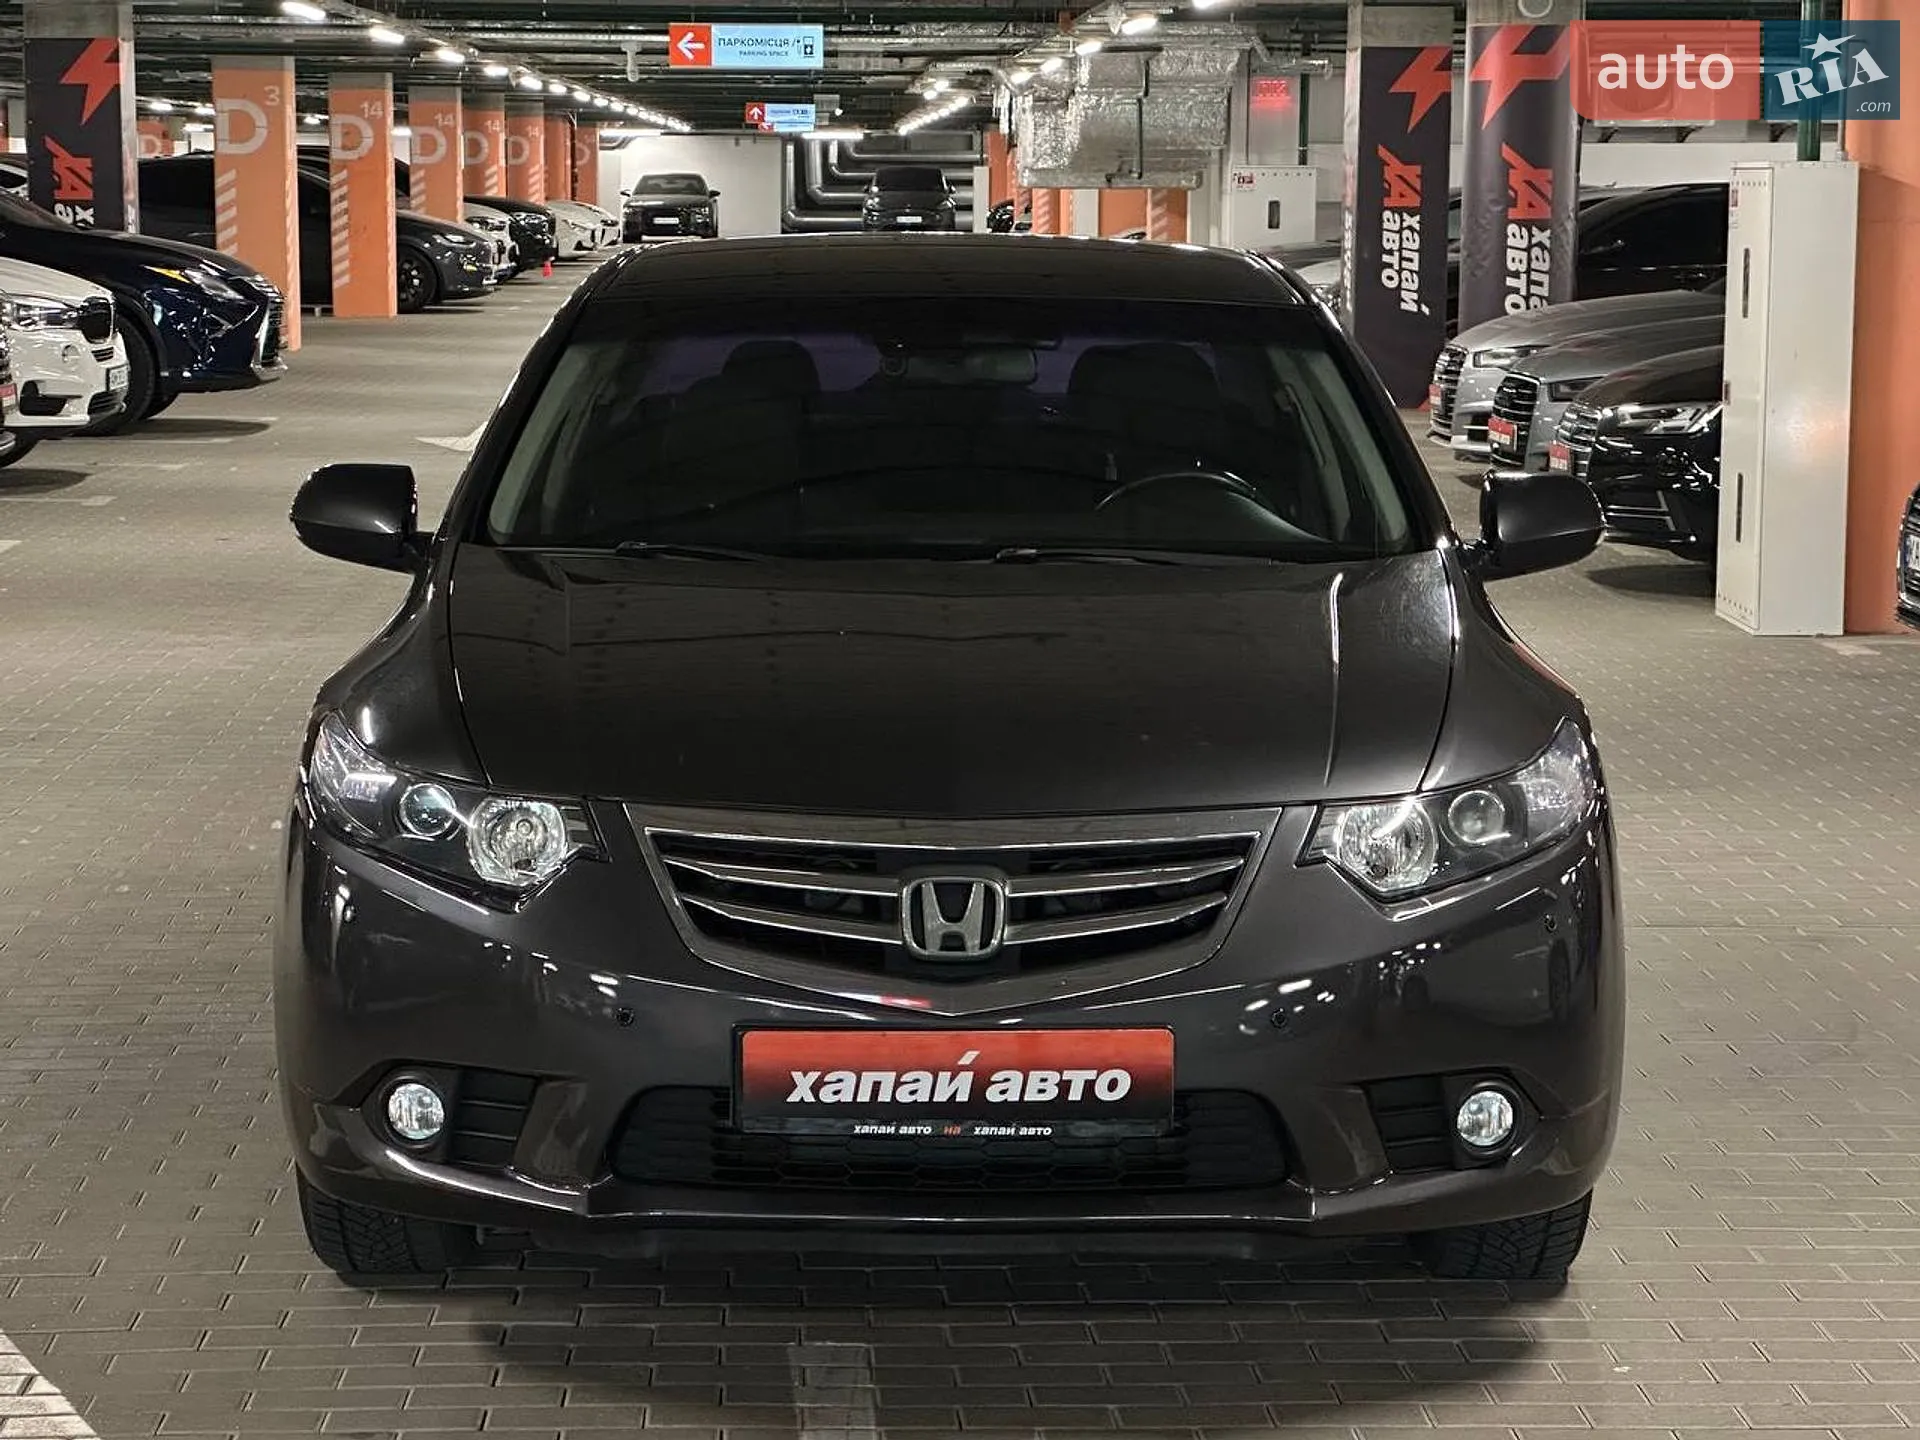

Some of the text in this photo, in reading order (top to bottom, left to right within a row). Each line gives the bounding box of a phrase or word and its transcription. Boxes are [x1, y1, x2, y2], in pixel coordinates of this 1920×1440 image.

[717, 37, 789, 48] ПАРКОМІСЦЯ
[215, 85, 281, 155] D 3
[330, 101, 384, 160] D 14
[411, 112, 456, 164] D 14
[464, 119, 501, 165] D 14
[507, 135, 530, 165] D
[1381, 210, 1400, 289] авто
[1400, 212, 1430, 316] хапай
[1505, 223, 1529, 316] авто
[786, 1050, 1132, 1103] хапай авто
[853, 1121, 1053, 1137] хапай авто на хапай авто
